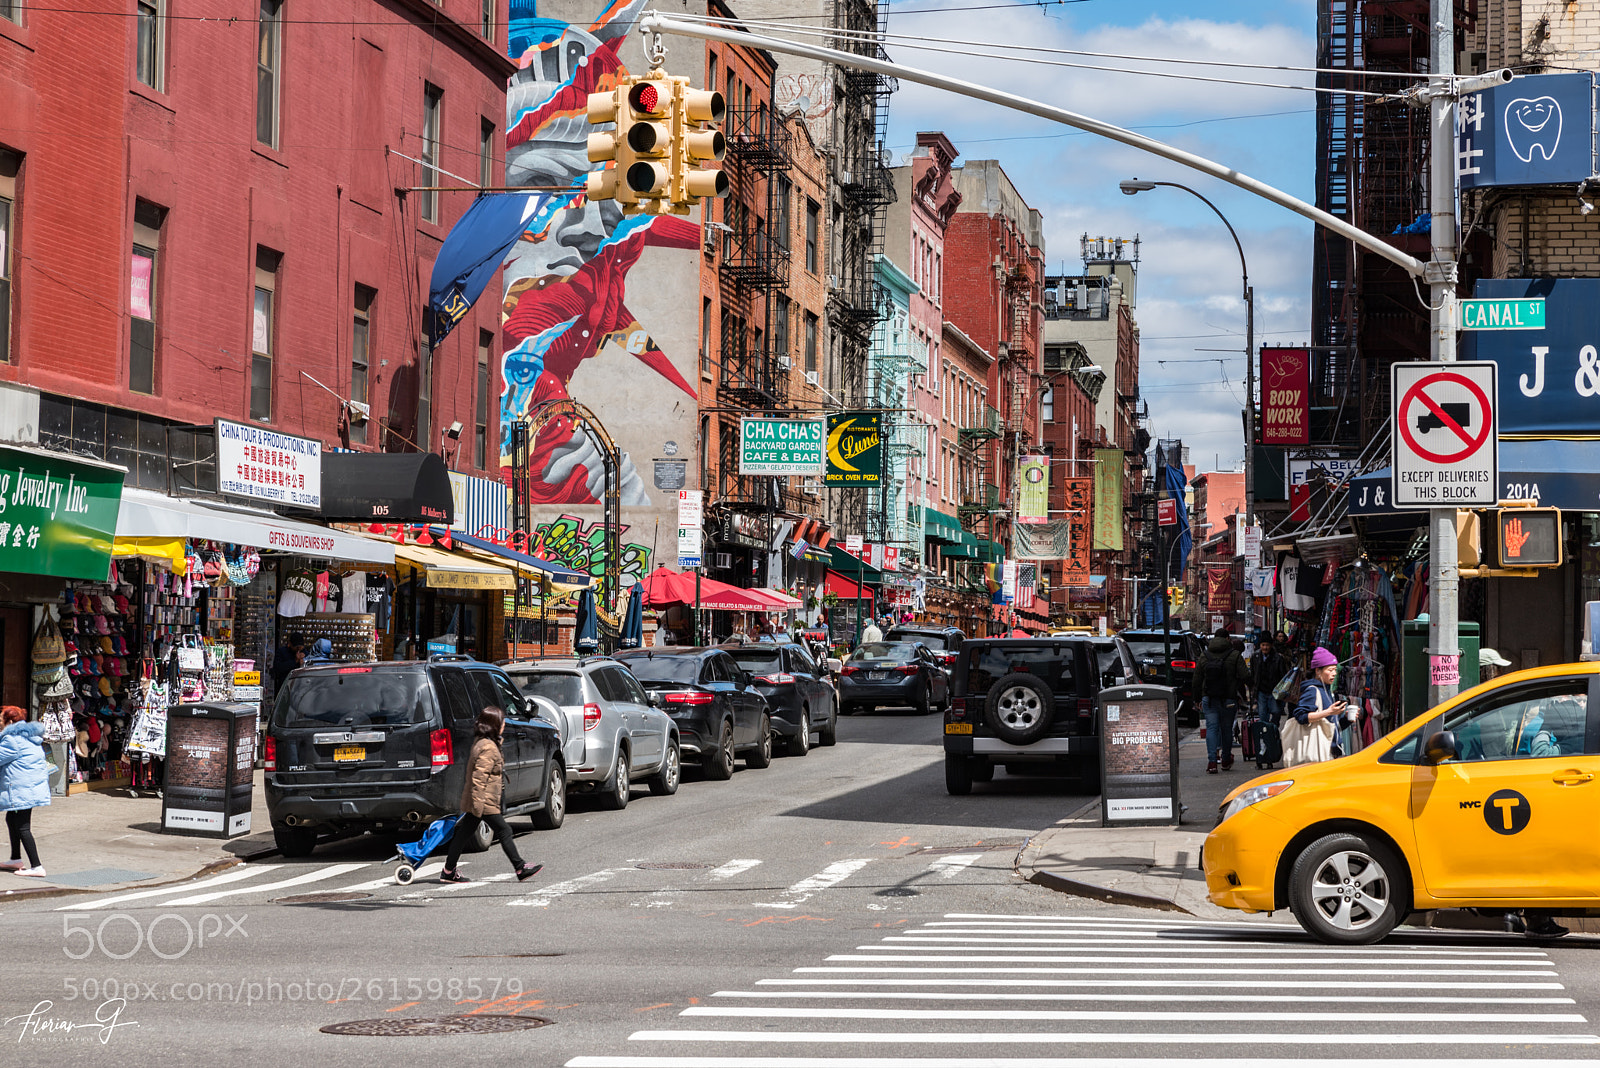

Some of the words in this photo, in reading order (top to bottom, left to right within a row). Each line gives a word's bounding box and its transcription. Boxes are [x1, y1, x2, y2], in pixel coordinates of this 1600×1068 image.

[1465, 303, 1524, 327] CANAL
[1529, 303, 1540, 315] ST
[1519, 346, 1549, 398] J
[1574, 344, 1600, 397] &
[1270, 390, 1301, 406] BODY
[1266, 407, 1303, 425] WORK
[745, 422, 775, 439] CHA
[778, 422, 821, 440] CHA'S
[220, 423, 240, 440] CHINA
[240, 427, 257, 444] TOUR
[257, 431, 263, 445] &
[263, 432, 306, 456] PRODUCTIONS,
[306, 441, 318, 457] INC.
[745, 441, 787, 451] BACKYARD
[788, 441, 821, 451] GARDEN
[842, 432, 880, 460] Luna
[744, 452, 777, 461] CAFE
[781, 452, 790, 462] &
[793, 452, 819, 462] BAR
[743, 463, 767, 471] PIZZERIA
[1402, 470, 1434, 483] EXCEPT
[1438, 470, 1489, 482] DELIVERIES
[11, 466, 64, 521] Jewelry
[64, 473, 89, 514] Inc.
[680, 491, 687, 499] 3
[1358, 486, 1369, 507] J
[1374, 485, 1385, 506] &
[1414, 486, 1437, 498] THIS
[1442, 486, 1477, 498] BLOCK
[1506, 483, 1541, 500] 201A
[372, 505, 389, 516] 105
[268, 530, 286, 548] GIFTS
[286, 533, 290, 546] &
[320, 538, 335, 551] SHOP
[679, 529, 686, 537] 2
[805, 632, 825, 641] ATM
[1441, 656, 1453, 664] NO
[1112, 737, 1124, 745] BIG
[1125, 736, 1163, 744] PROBLEMS
[1460, 801, 1481, 809] NYC
[1493, 797, 1520, 830] T
